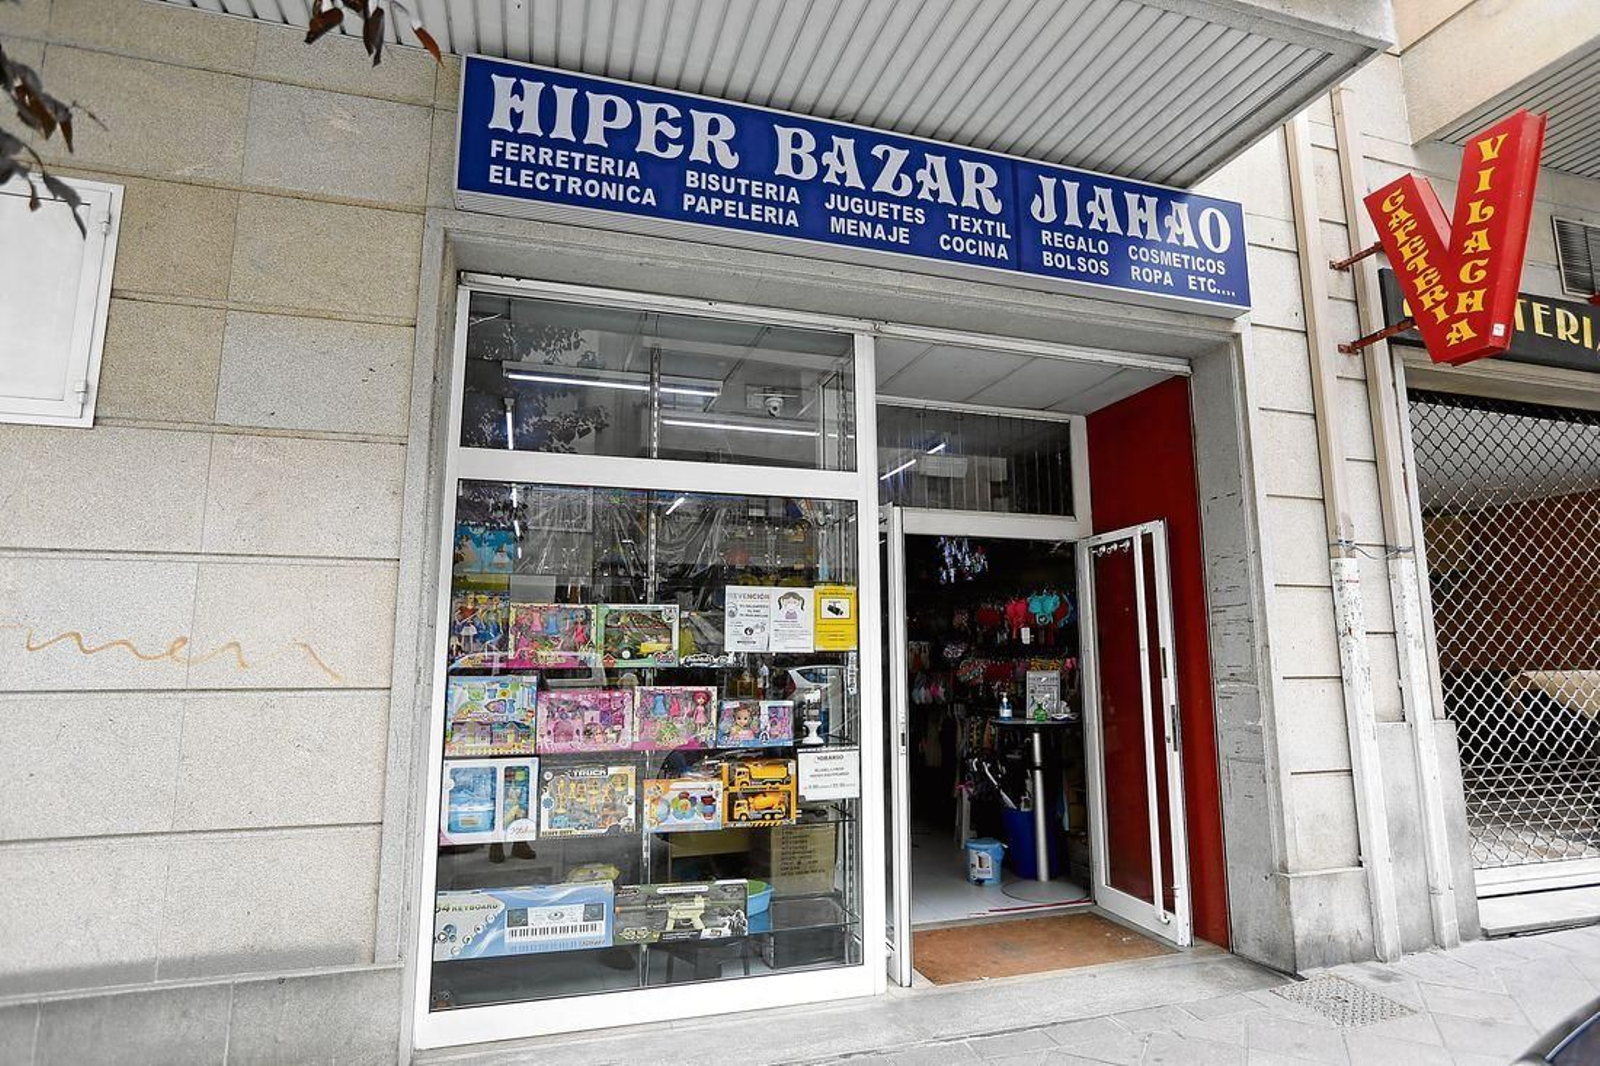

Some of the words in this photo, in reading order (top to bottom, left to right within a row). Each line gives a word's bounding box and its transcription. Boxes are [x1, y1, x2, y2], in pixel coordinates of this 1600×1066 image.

[488, 73, 740, 170] HIPER
[773, 124, 1003, 215] BAZAR
[1030, 174, 1232, 254] JIAHAO
[489, 164, 657, 206] ELECTRONICA
[683, 193, 799, 228] PAPELERIA
[830, 216, 910, 245] MENAJE
[939, 234, 1009, 260] COCINA
[1042, 250, 1110, 276] BOLSOS
[1130, 265, 1175, 287] ROPA
[490, 139, 641, 180] FERRETERIA
[685, 169, 801, 204] BISUTERIA
[824, 193, 926, 225] JUGUETES
[947, 213, 1012, 239] TEXTIL
[1041, 229, 1109, 255] REGALO
[1128, 245, 1226, 276] COSMETICOS
[451, 903, 498, 912] KEYBOARD
